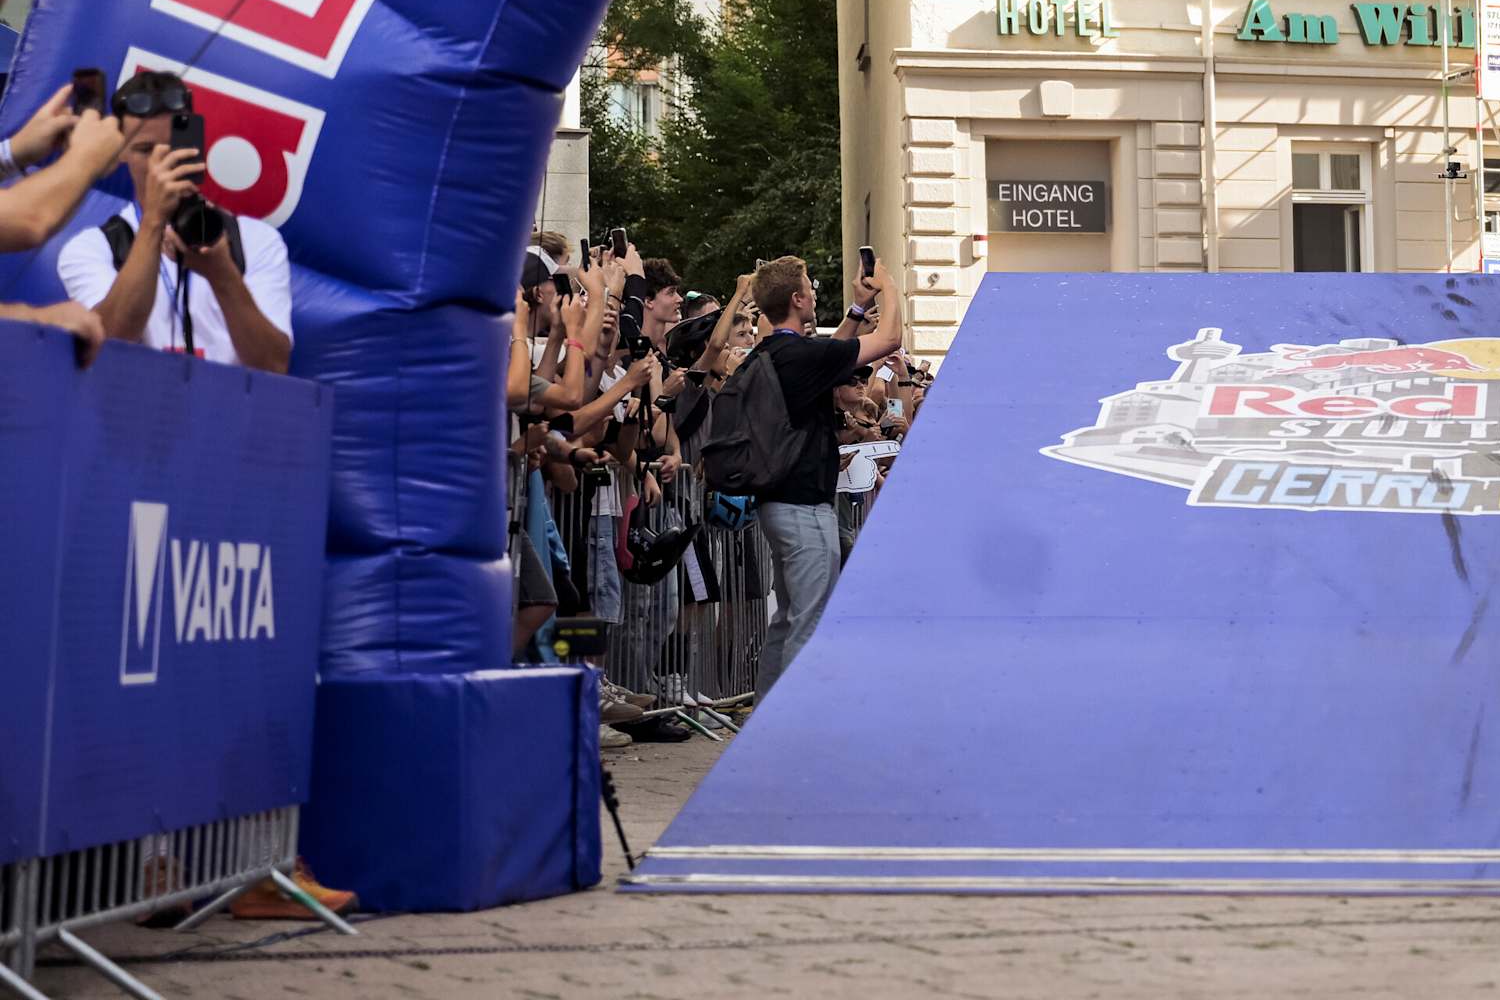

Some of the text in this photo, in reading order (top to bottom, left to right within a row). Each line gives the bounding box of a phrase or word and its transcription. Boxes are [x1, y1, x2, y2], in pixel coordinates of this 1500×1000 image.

[998, 183, 1094, 203] EINGANG
[1012, 209, 1081, 228] HOTEL
[1207, 384, 1480, 418] Red
[1213, 461, 1474, 510] CERRO
[170, 539, 275, 645] VARTA
